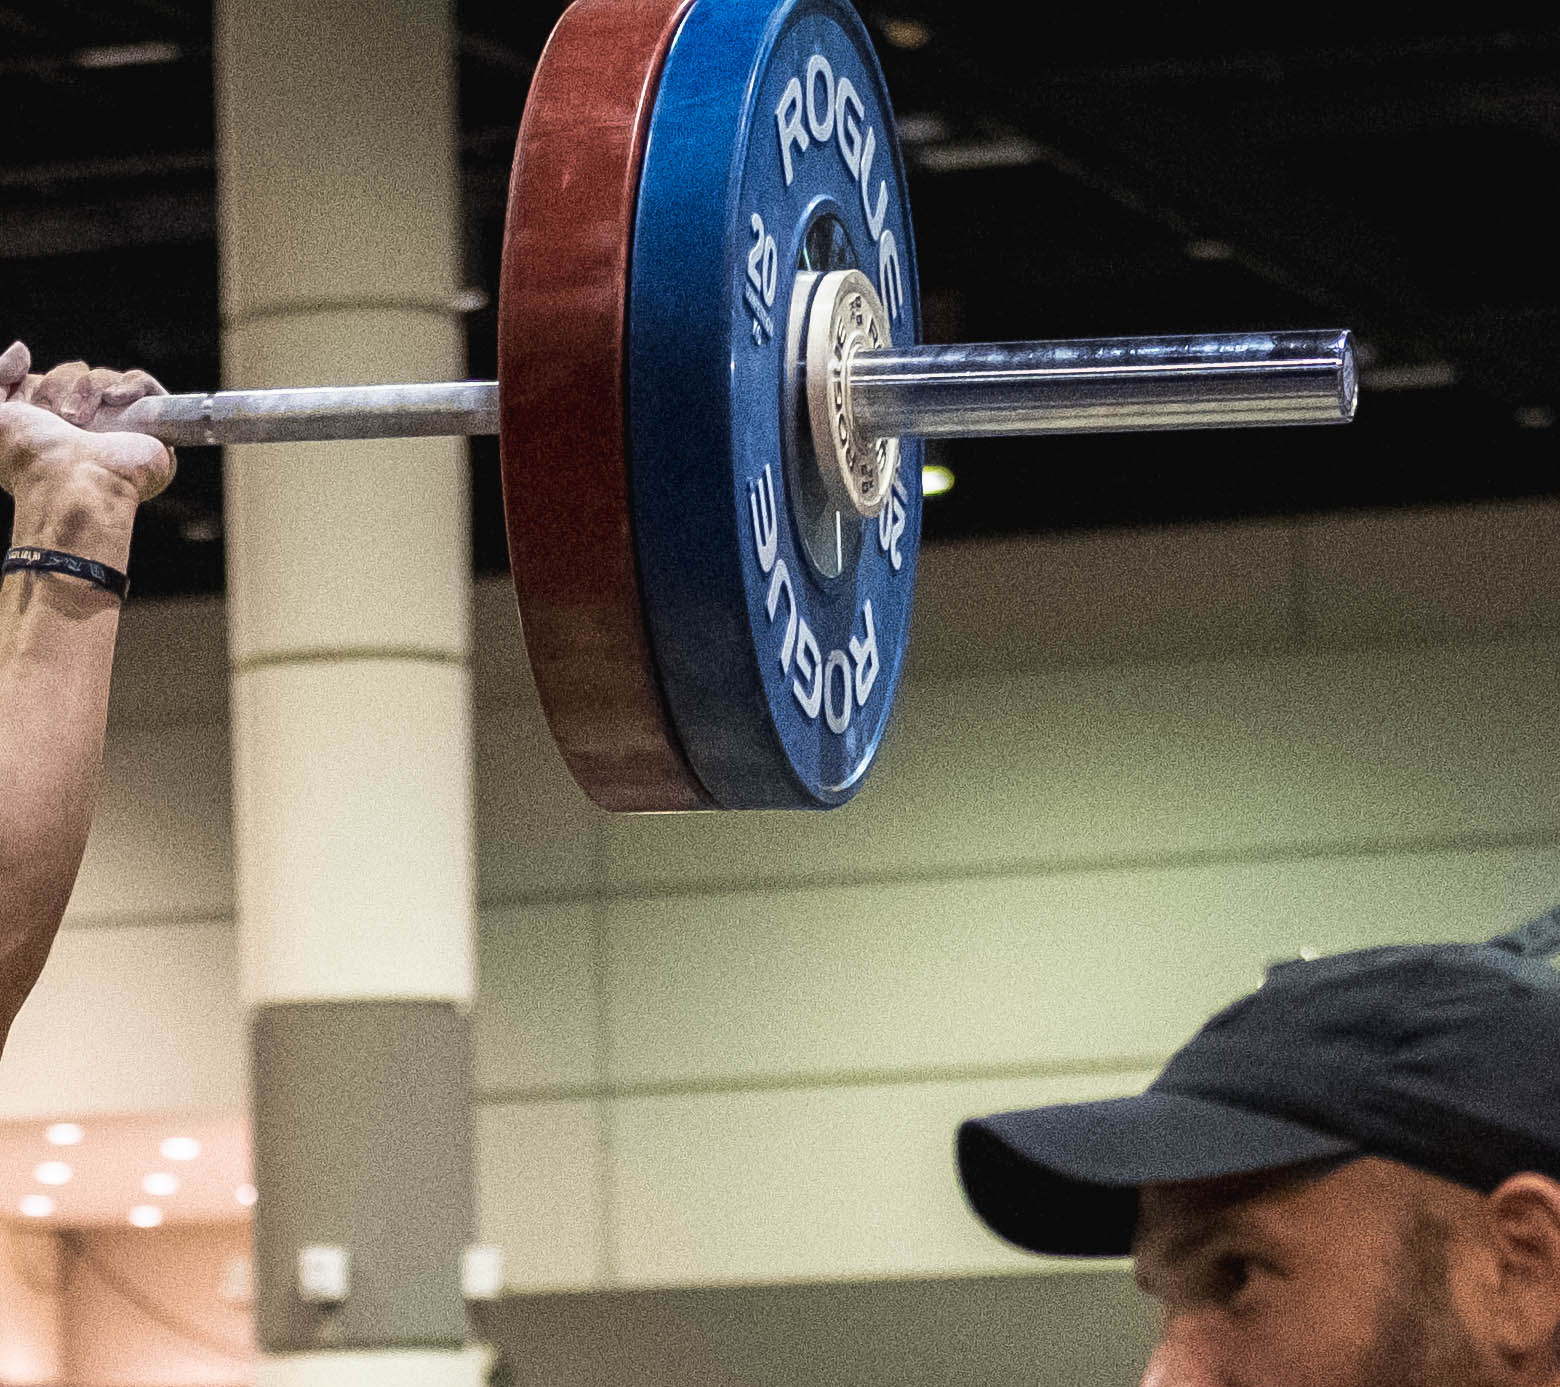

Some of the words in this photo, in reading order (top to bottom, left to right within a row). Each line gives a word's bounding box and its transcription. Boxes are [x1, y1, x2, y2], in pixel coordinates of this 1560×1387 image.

[747, 212, 778, 307] 20
[776, 55, 904, 321] ROGUE
[749, 464, 878, 735] ROGUE
